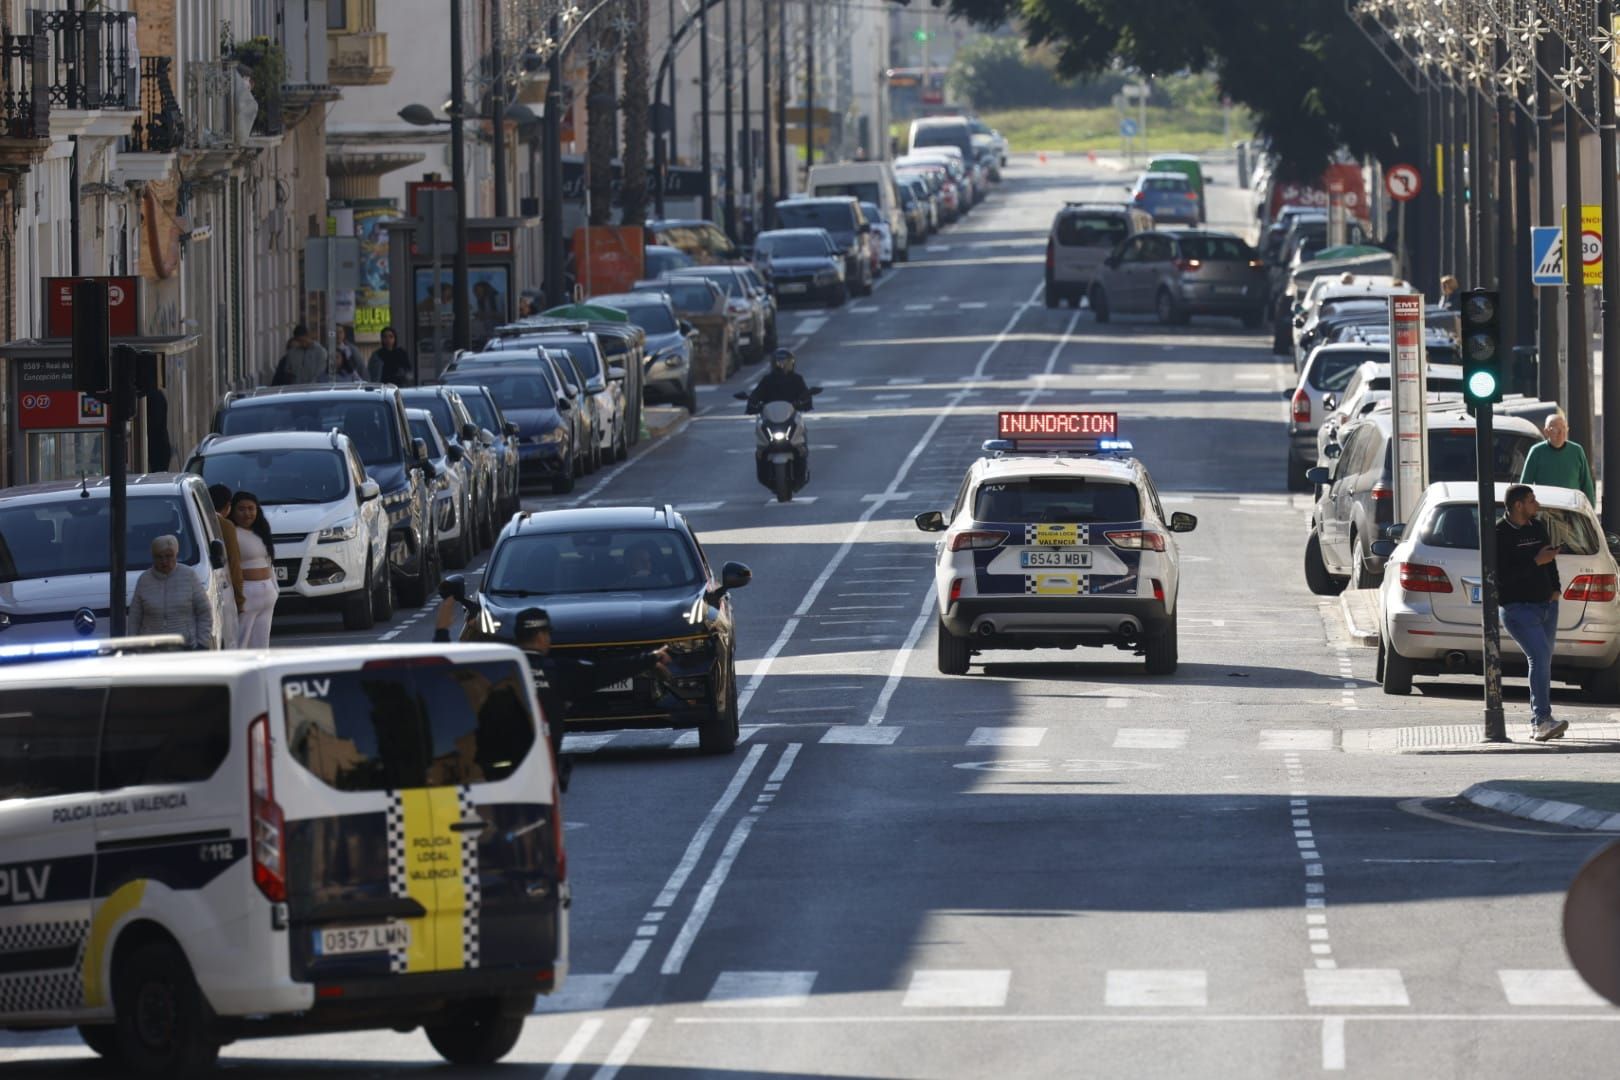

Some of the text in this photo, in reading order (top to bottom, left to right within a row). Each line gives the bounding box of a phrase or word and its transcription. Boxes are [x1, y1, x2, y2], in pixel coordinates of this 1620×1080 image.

[1582, 242, 1599, 254] 30
[1001, 414, 1115, 433] INUNDACION
[1030, 553, 1088, 565] 6543 MBW
[285, 678, 331, 700] PLV
[52, 805, 92, 823] POLICIA
[95, 800, 129, 817] LOCAL
[210, 843, 234, 860] 112
[416, 851, 449, 863] LOCAL
[325, 929, 370, 951] 0357
